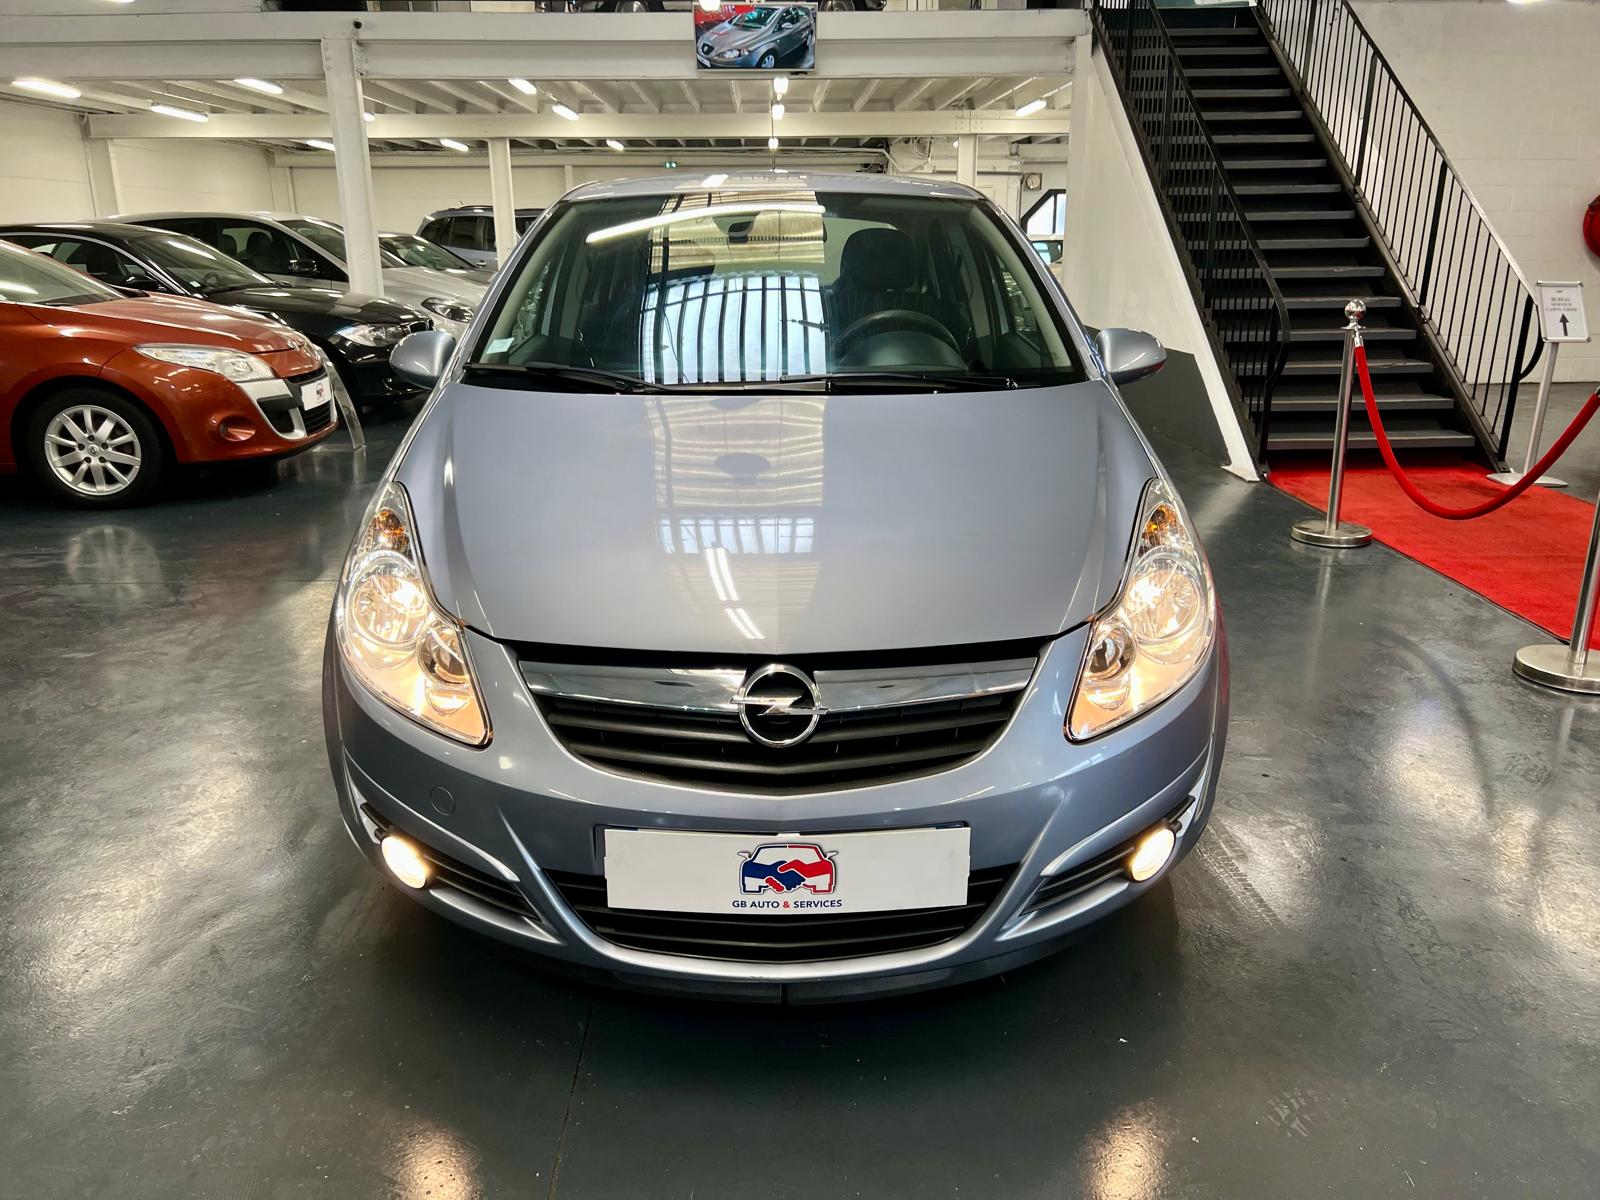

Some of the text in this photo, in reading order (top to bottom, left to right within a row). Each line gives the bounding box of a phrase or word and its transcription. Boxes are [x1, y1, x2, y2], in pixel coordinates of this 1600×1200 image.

[732, 899, 842, 908] GB AUTO & SERVICES
